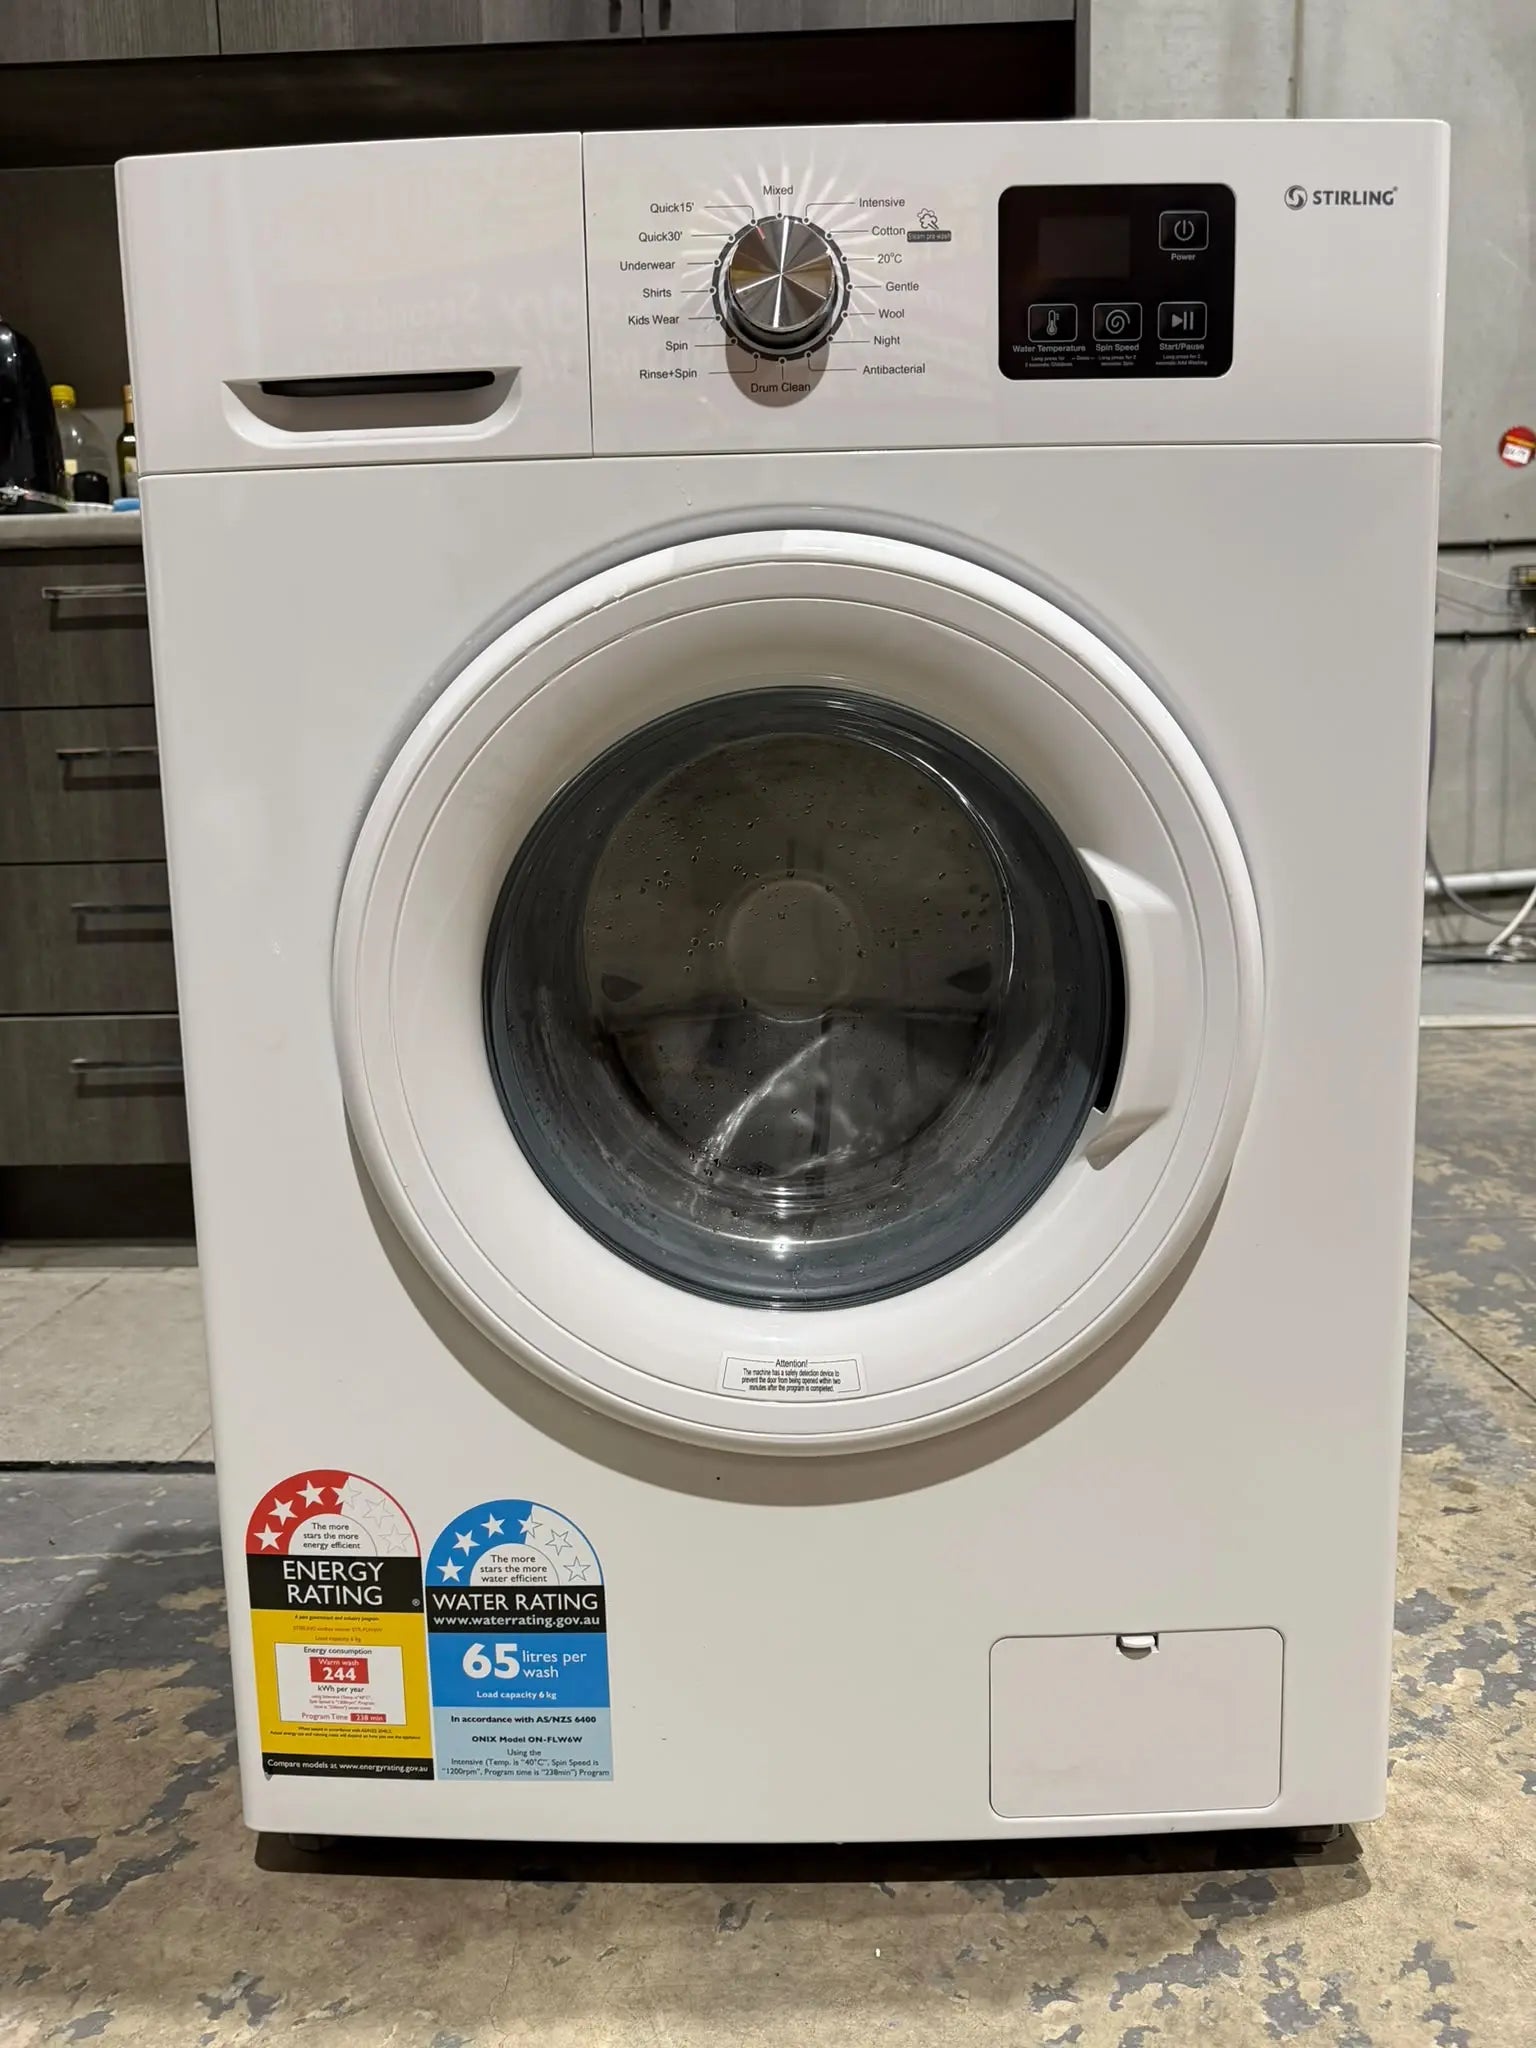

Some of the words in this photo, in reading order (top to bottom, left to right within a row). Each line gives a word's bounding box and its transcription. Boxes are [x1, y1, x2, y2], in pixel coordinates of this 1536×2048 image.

[763, 185, 794, 195] Mixed
[859, 197, 906, 208] Intensive
[1312, 189, 1394, 206] STIRLING
[650, 202, 695, 215] Quick15'
[638, 231, 683, 243] Quick30'
[872, 226, 906, 237] Cotton
[877, 252, 903, 264] 20°C
[1171, 253, 1196, 262] Power
[619, 260, 675, 272] Underwear
[885, 281, 920, 292] Gentle
[643, 287, 672, 298] Shirts
[878, 308, 905, 319] Wool
[628, 315, 649, 326] Kids
[652, 315, 680, 326] Wear
[665, 340, 689, 354] Spin
[874, 335, 901, 348] Night
[1159, 343, 1205, 351] Start/Pause
[1012, 344, 1036, 353] Water
[1036, 344, 1086, 353] Temperature
[1095, 343, 1113, 352] Spin
[1114, 343, 1140, 352] Speed
[862, 363, 926, 375] Antibacterial
[639, 368, 698, 382] Rinse+Spin
[750, 382, 779, 394] Drum
[781, 382, 811, 393] Clean
[775, 1359, 809, 1368] Attention!
[312, 1522, 327, 1531] The
[323, 1532, 337, 1540] the
[303, 1542, 329, 1550] energy
[330, 1541, 361, 1549] efficient
[490, 1554, 509, 1563] The
[282, 1560, 384, 1582] ENERGY
[480, 1565, 503, 1573] stars
[504, 1564, 520, 1573] the
[480, 1575, 508, 1583] water
[510, 1574, 548, 1583] efficient
[286, 1584, 383, 1606] RATING
[432, 1593, 509, 1611] WATER
[515, 1593, 598, 1611] RATING
[432, 1615, 600, 1628] www.waterrating.gov.au
[303, 1646, 327, 1655] Energy
[328, 1647, 373, 1655] consumption
[318, 1658, 340, 1666] Warm
[462, 1642, 521, 1680] 65
[522, 1651, 558, 1663] litres
[562, 1652, 587, 1666] per
[322, 1667, 357, 1681] 244
[522, 1666, 559, 1679] wash
[317, 1684, 335, 1692] kWh
[336, 1686, 349, 1694] per
[476, 1690, 499, 1699] Load
[499, 1691, 538, 1701] capacity
[538, 1691, 545, 1699] 6
[546, 1691, 557, 1701] kg
[301, 1712, 331, 1721] Program
[331, 1713, 348, 1721] Time
[450, 1715, 460, 1723] In
[536, 1716, 573, 1724] AS/NZS
[471, 1735, 497, 1743] ONIX
[499, 1735, 526, 1743] Model
[506, 1748, 528, 1758] Using
[267, 1758, 301, 1768] Compare
[302, 1761, 329, 1769] models
[339, 1763, 429, 1773] www.energyrating.gov.au
[451, 1758, 484, 1766] Intensive
[551, 1759, 567, 1767] Spin
[568, 1759, 591, 1768] Speed
[484, 1768, 515, 1778] Program
[579, 1769, 610, 1778] Program
